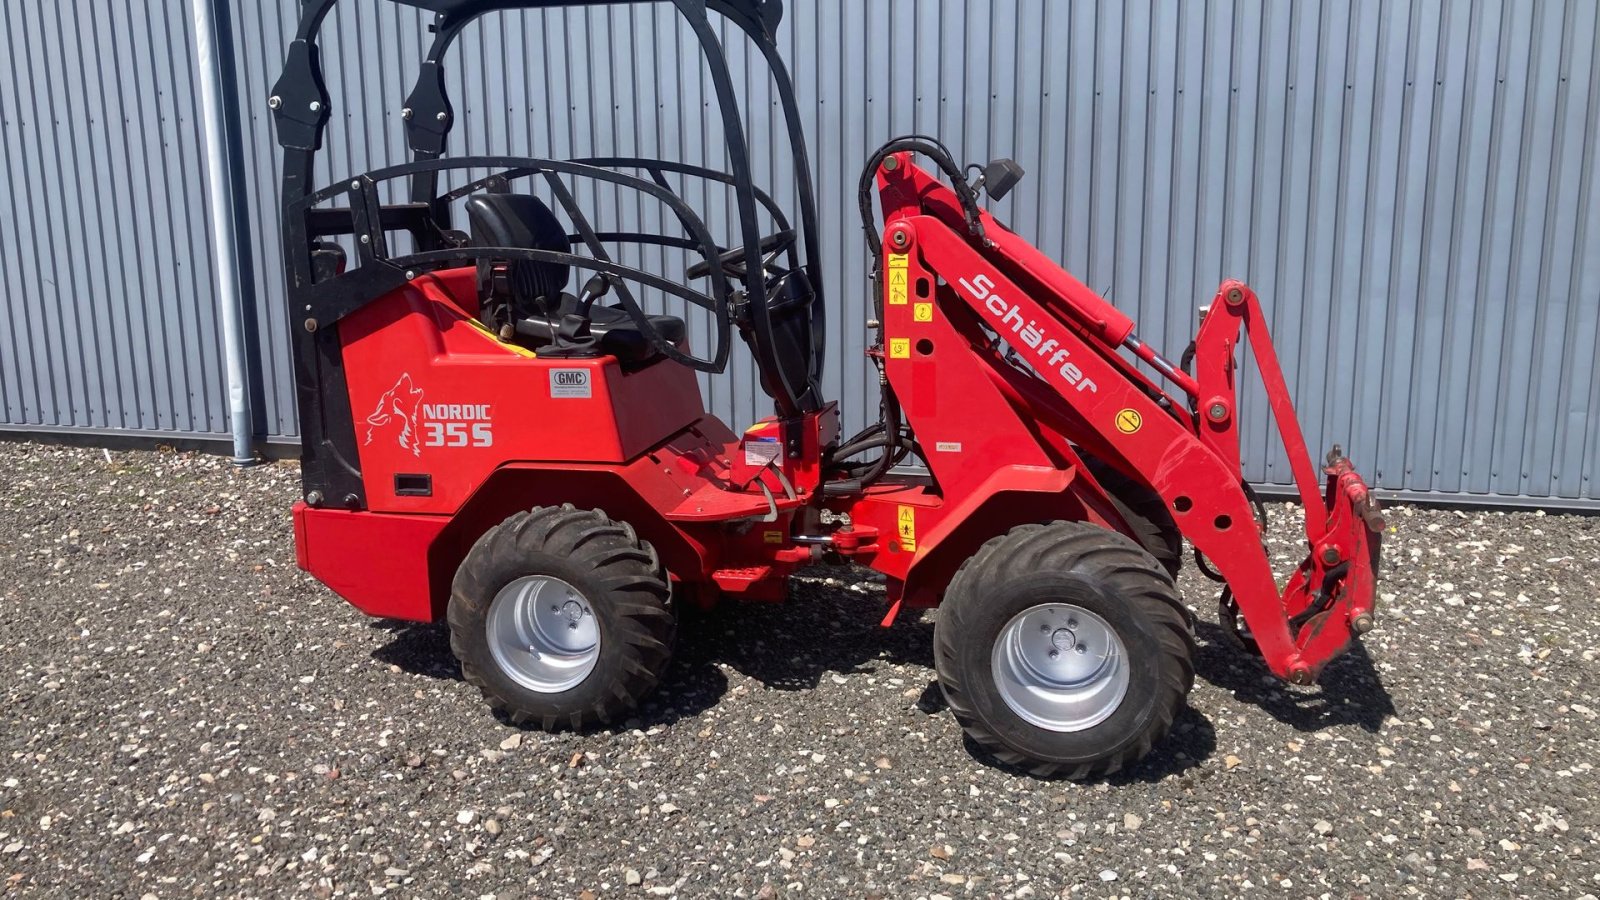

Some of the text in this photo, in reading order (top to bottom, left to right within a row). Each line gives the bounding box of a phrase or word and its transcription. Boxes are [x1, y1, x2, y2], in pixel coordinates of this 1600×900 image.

[958, 273, 1098, 395] Schäffer
[558, 373, 583, 384] GMC
[422, 404, 492, 420] NORDIC
